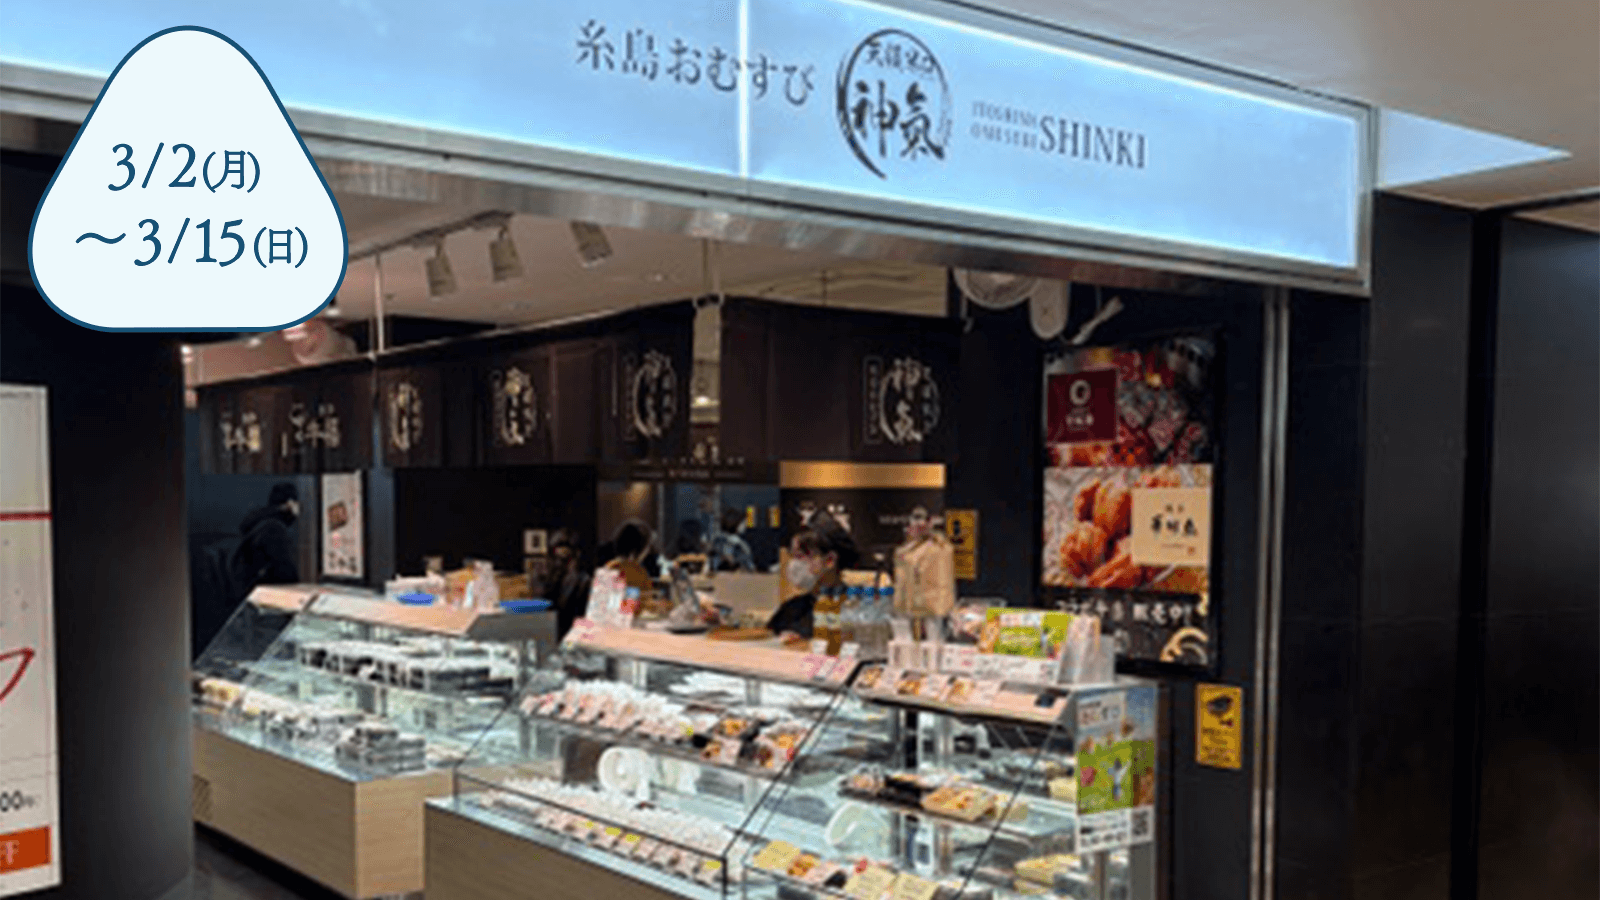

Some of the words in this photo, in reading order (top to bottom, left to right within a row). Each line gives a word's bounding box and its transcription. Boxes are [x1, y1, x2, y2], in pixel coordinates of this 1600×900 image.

[575, 18, 815, 107] 糸島おむすび
[1039, 114, 1148, 170] SHINKI
